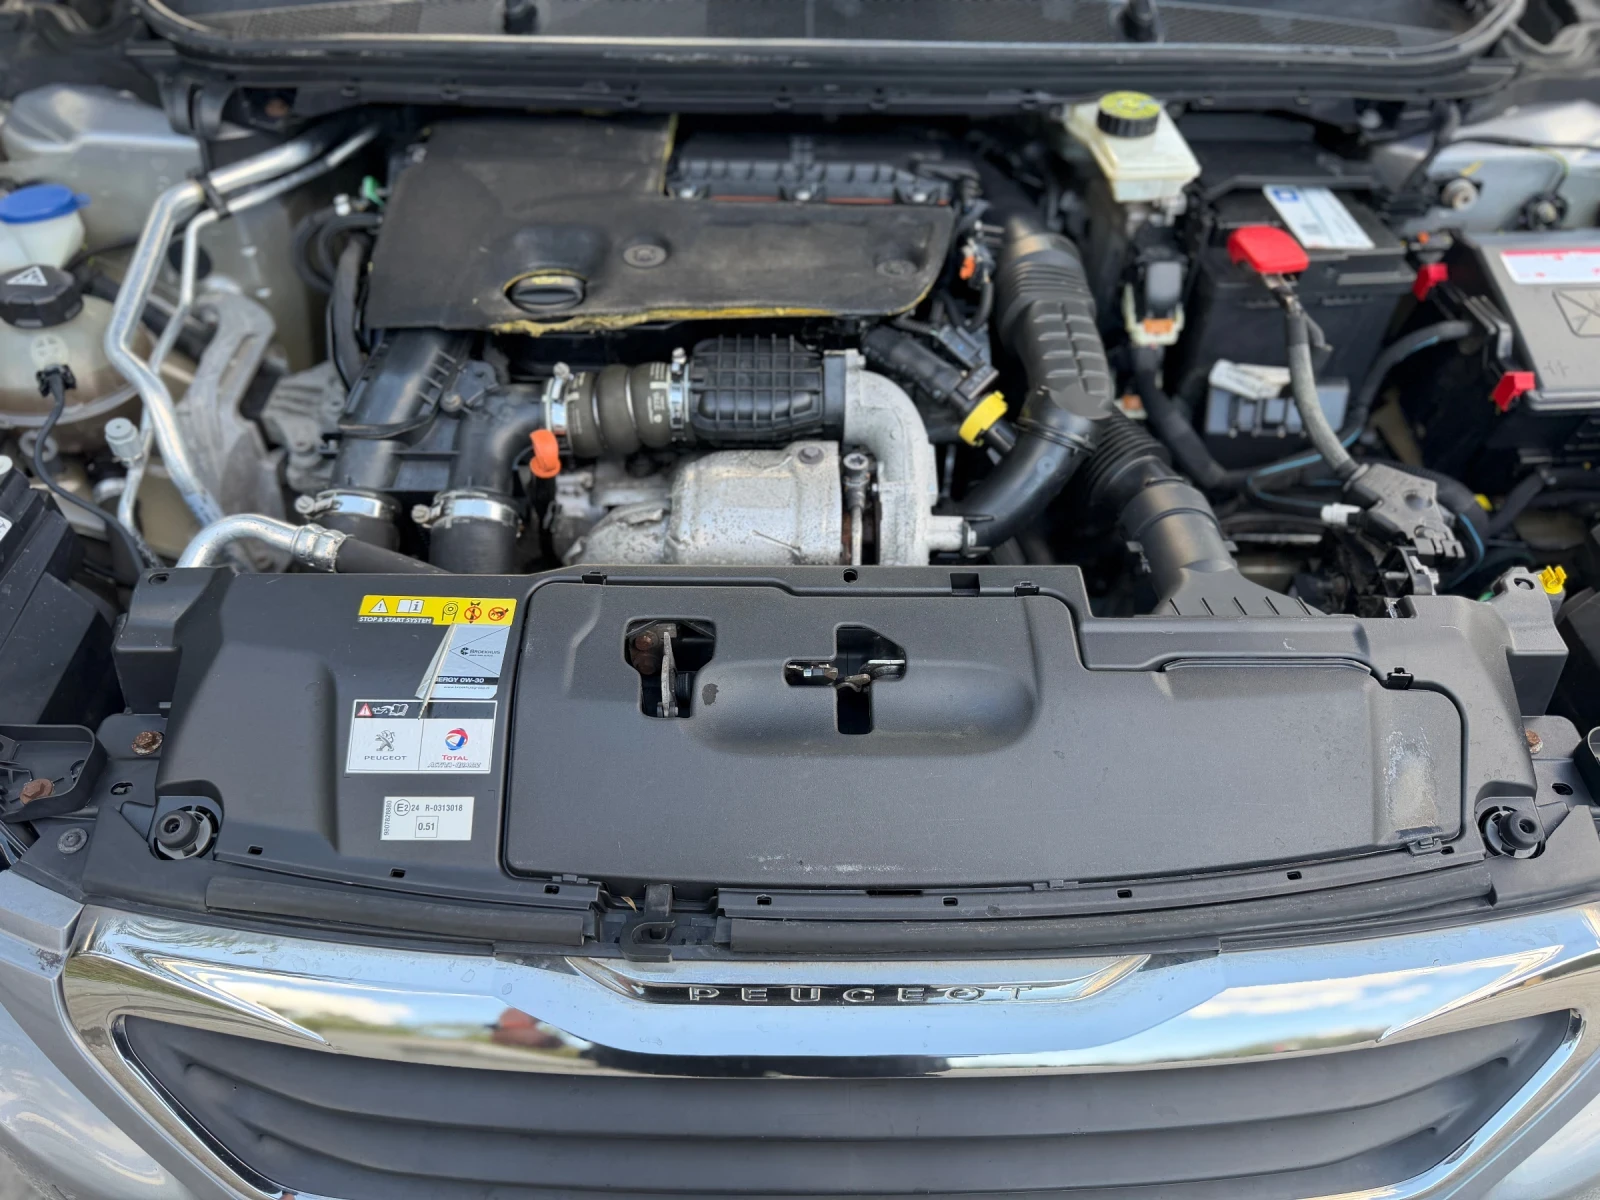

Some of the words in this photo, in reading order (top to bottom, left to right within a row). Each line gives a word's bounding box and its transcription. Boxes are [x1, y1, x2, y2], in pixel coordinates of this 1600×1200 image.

[424, 804, 463, 812] R-0313018
[417, 822, 436, 831] 0.51
[688, 985, 1033, 1003] PEUGEOT
